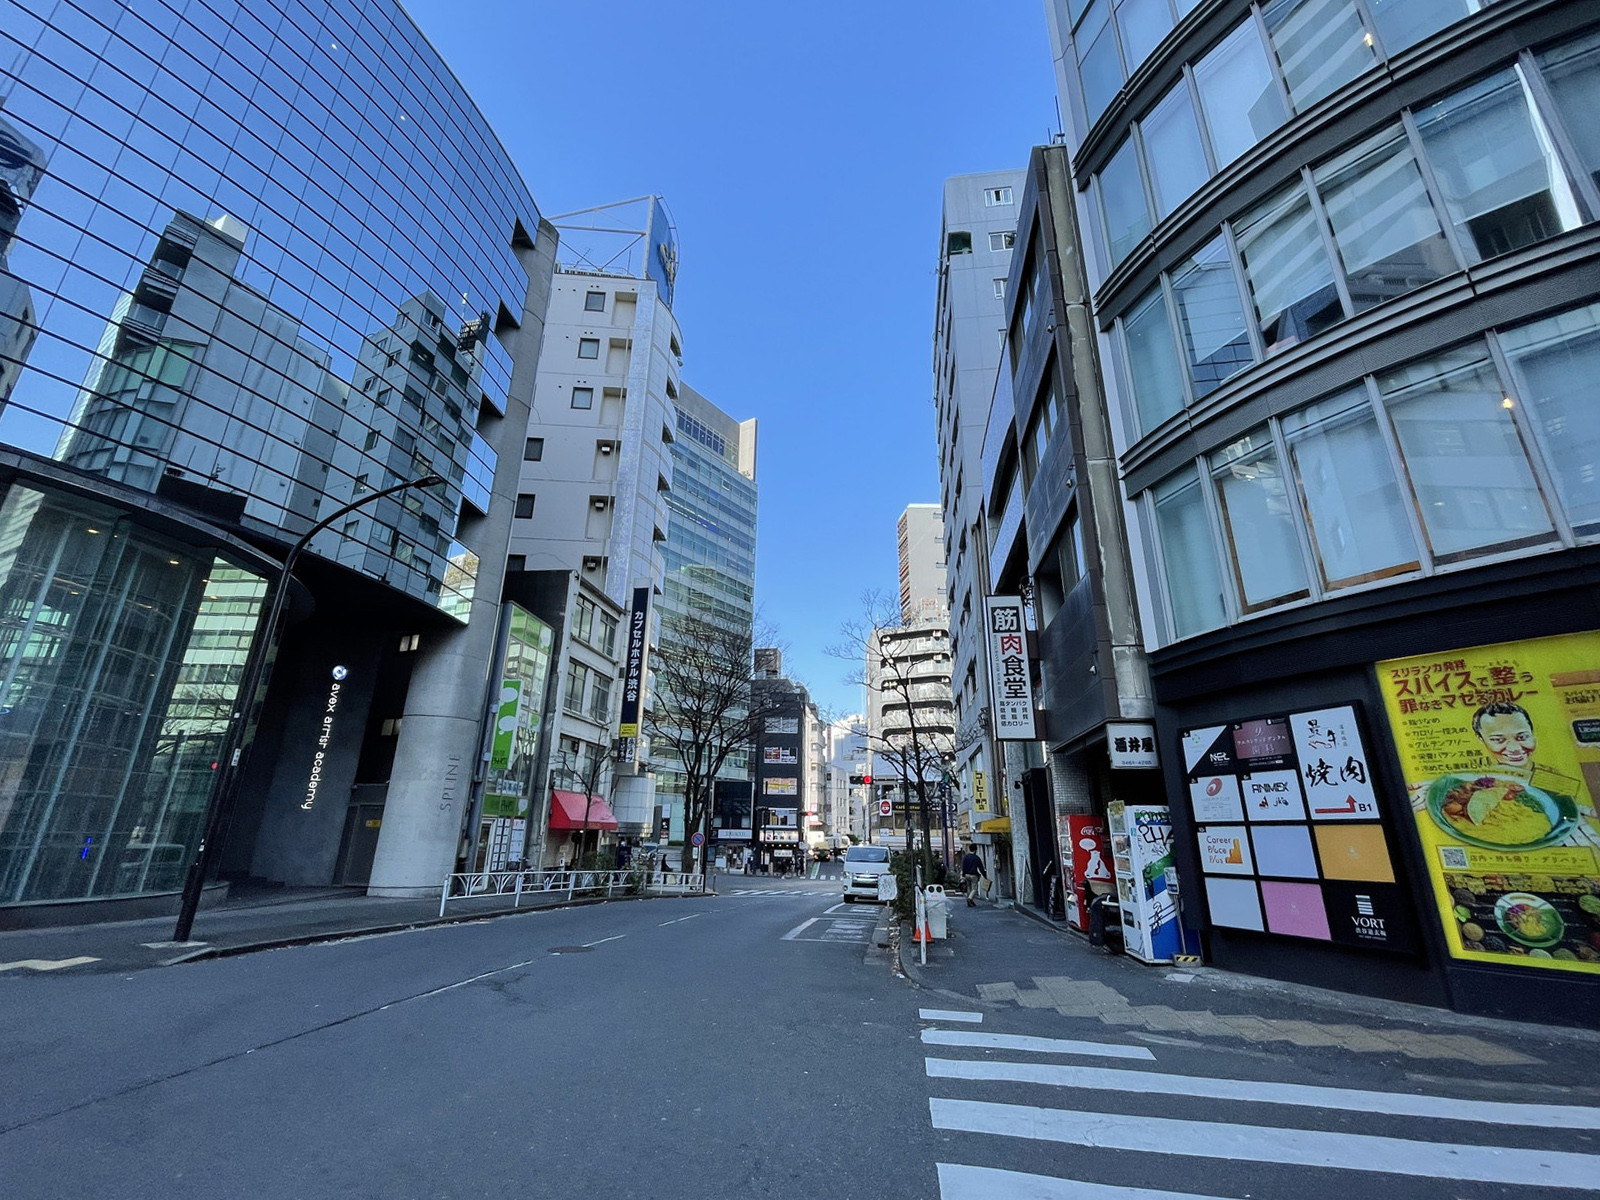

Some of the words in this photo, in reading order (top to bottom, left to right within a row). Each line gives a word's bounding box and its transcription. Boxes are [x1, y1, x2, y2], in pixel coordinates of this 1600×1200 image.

[627, 611, 644, 702] カプセルホテル渋谷
[994, 608, 1028, 699] 筋肉食堂
[327, 683, 340, 712] avex
[1394, 666, 1534, 697] スパイスで整う
[301, 751, 325, 810] academy
[440, 754, 461, 812] SPLINE
[1305, 757, 1366, 787] 焼肉
[1351, 916, 1385, 928] VORT
